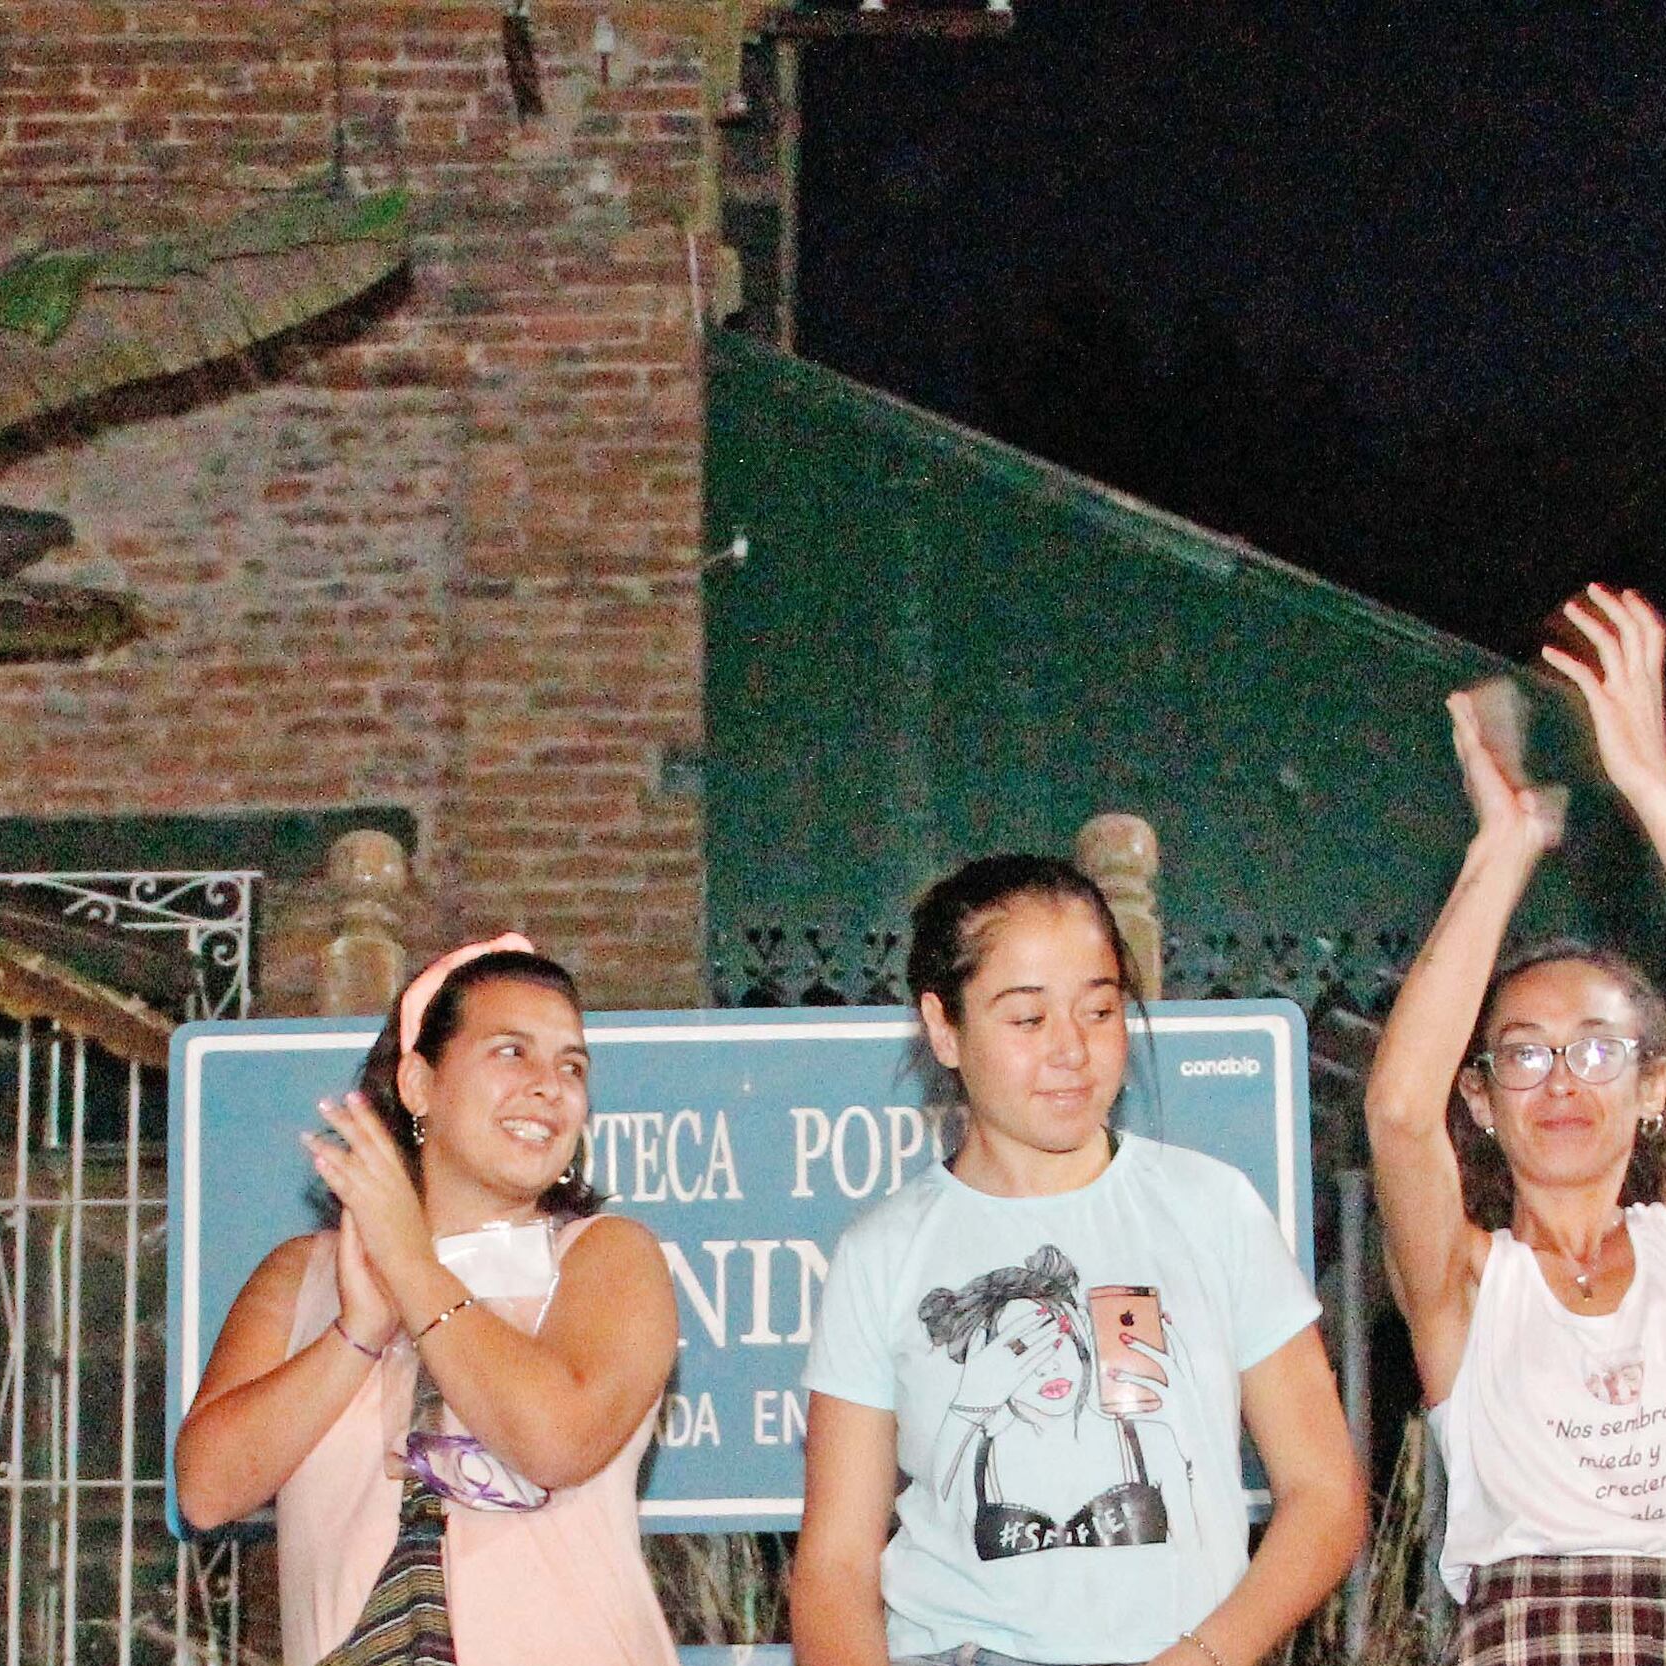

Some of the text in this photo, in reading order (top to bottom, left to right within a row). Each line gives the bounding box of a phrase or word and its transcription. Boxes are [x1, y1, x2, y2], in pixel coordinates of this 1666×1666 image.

[661, 1391, 721, 1448] DA
[1579, 1445, 1642, 1470] miedo
[1649, 1444, 1661, 1468] y
